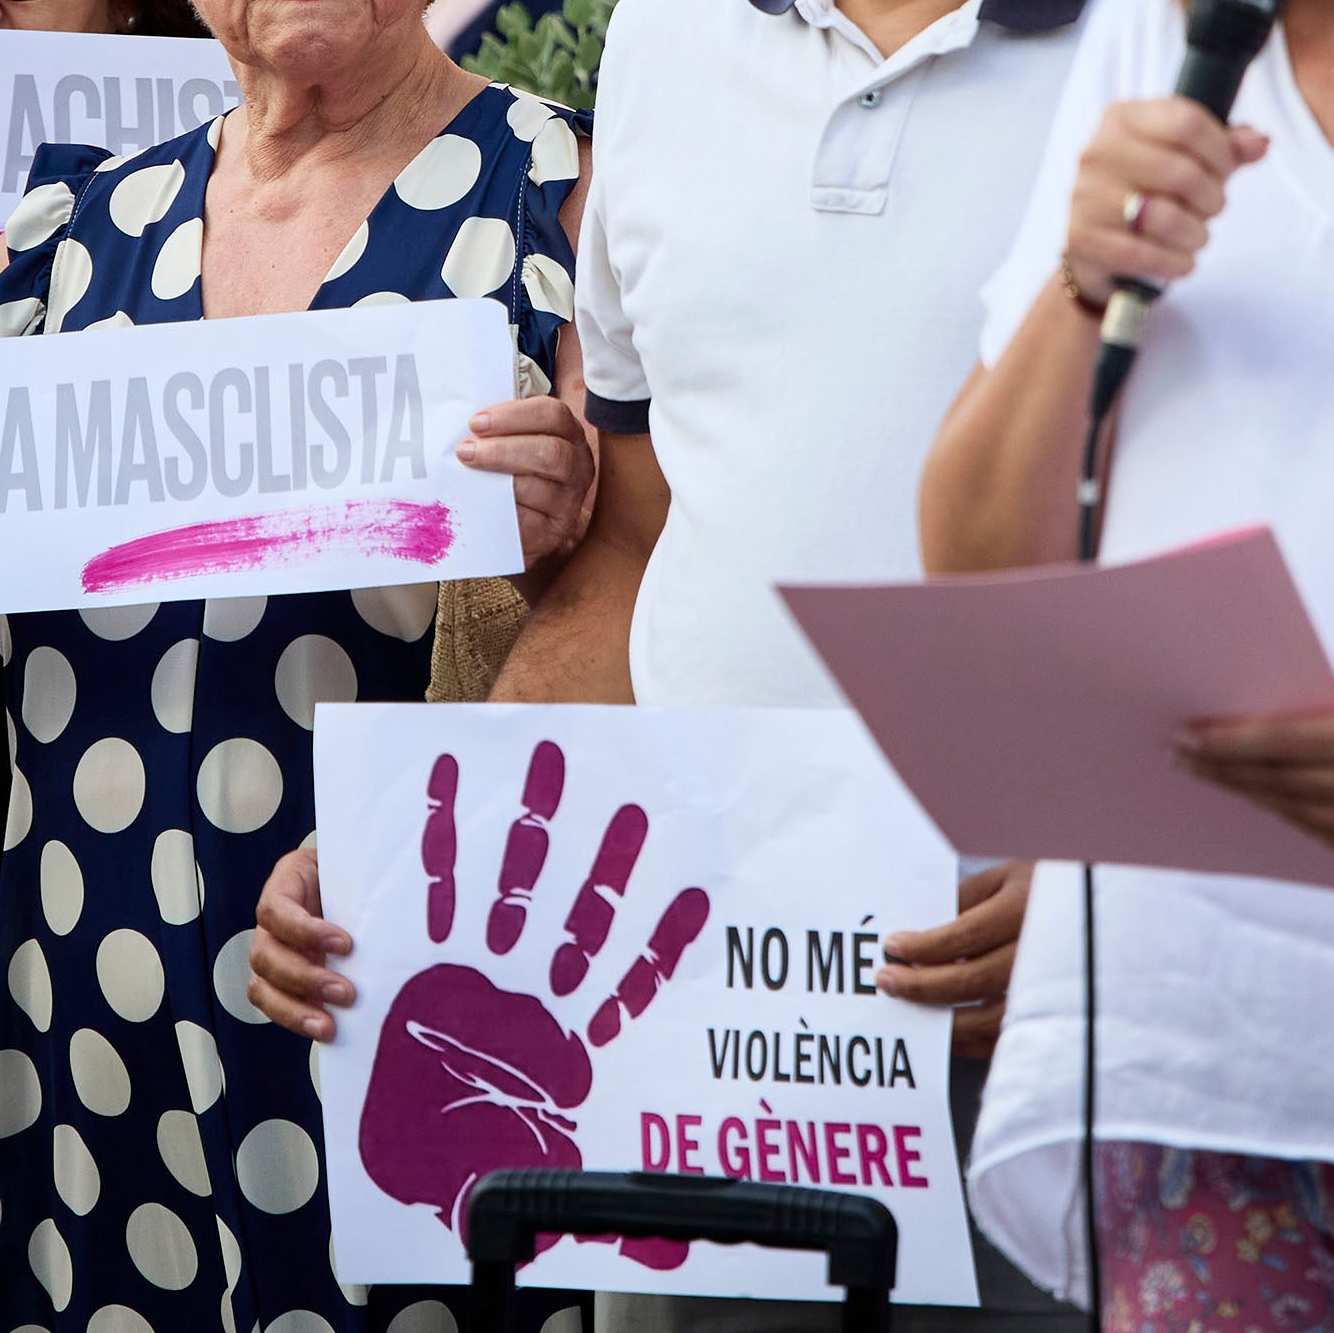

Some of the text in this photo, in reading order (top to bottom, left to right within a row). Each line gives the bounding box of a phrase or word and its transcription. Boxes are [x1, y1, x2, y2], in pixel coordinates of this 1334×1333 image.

[54, 354, 427, 511] MASCLISTA
[725, 915, 897, 996] NO MÉ
[707, 1016, 916, 1089] VIOLÈNCIA
[640, 1097, 929, 1188] DE GÈNERE
